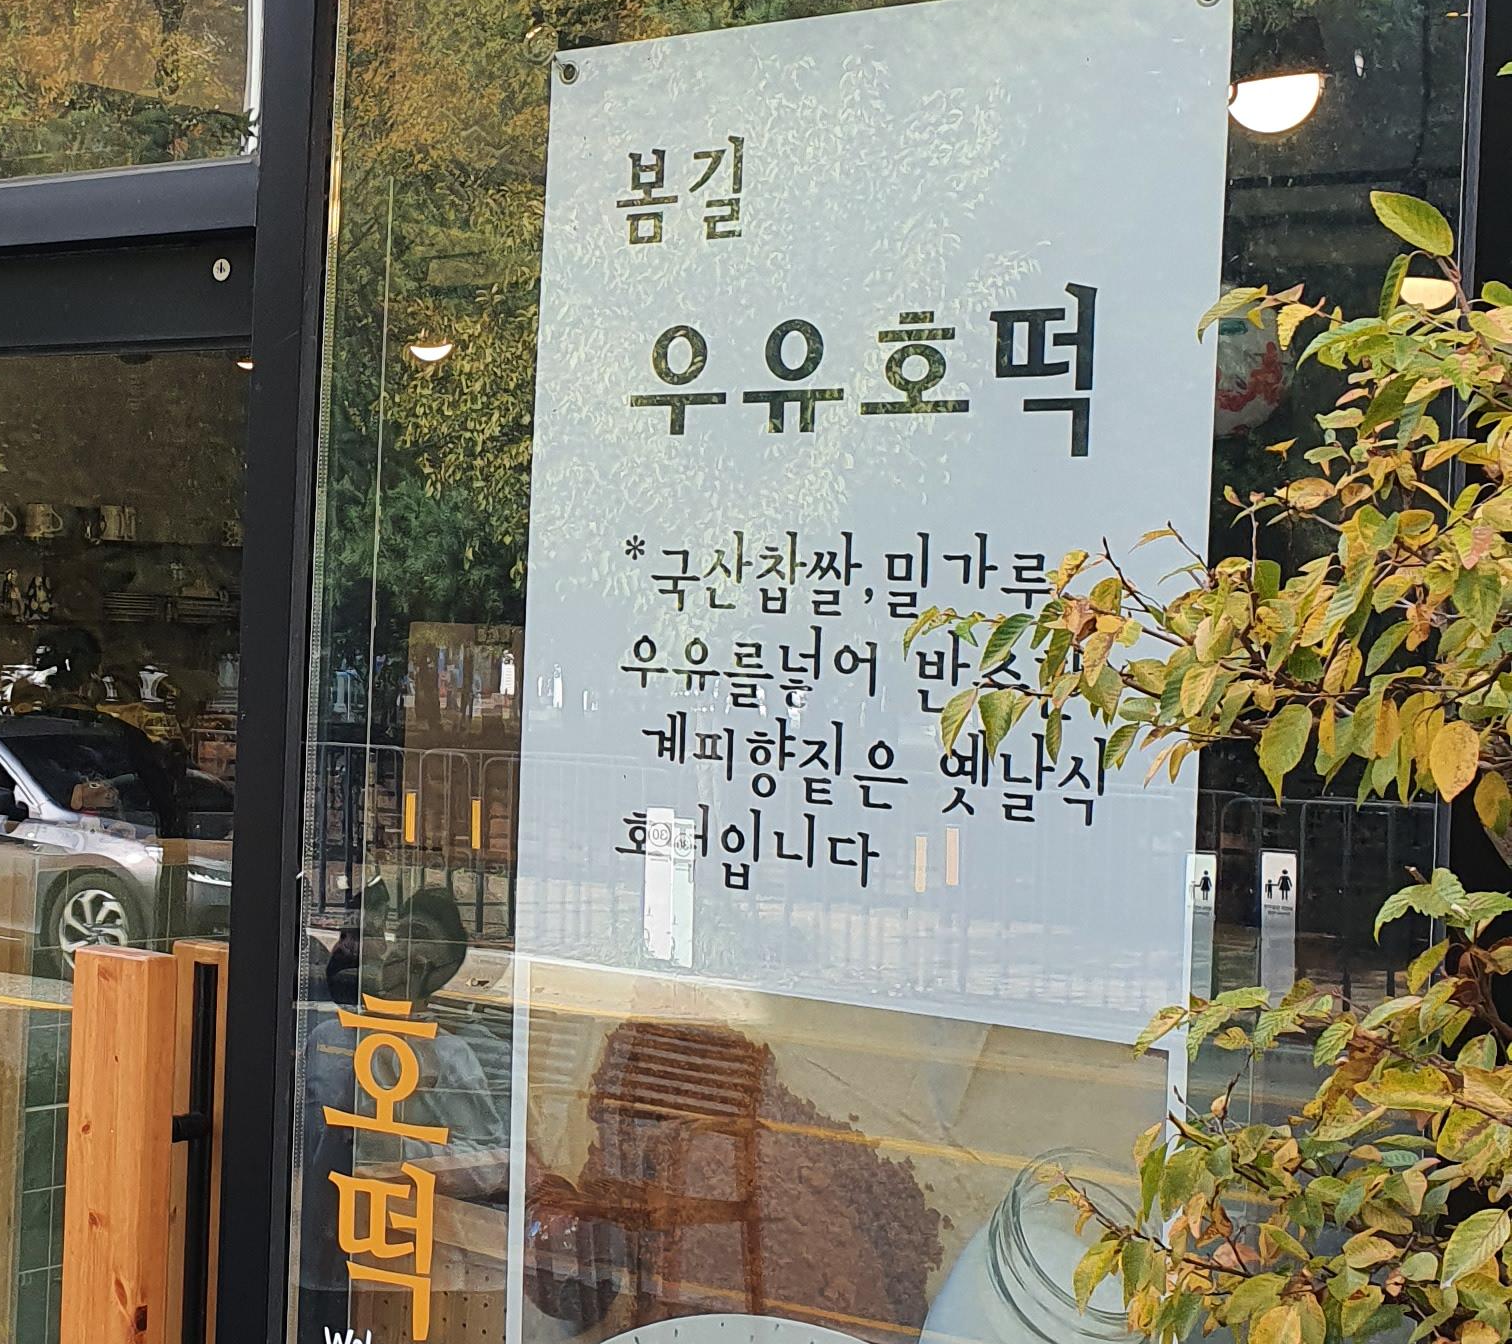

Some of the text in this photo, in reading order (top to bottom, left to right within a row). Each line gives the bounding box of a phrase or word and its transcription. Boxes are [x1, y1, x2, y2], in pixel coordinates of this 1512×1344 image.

[615, 135, 746, 245] 봄길
[629, 281, 1099, 458] 우유호떡
[620, 625, 879, 709] 우유를넣어
[642, 712, 1108, 827] 계피향짙은 옛날식
[322, 991, 449, 1341] 호떡
